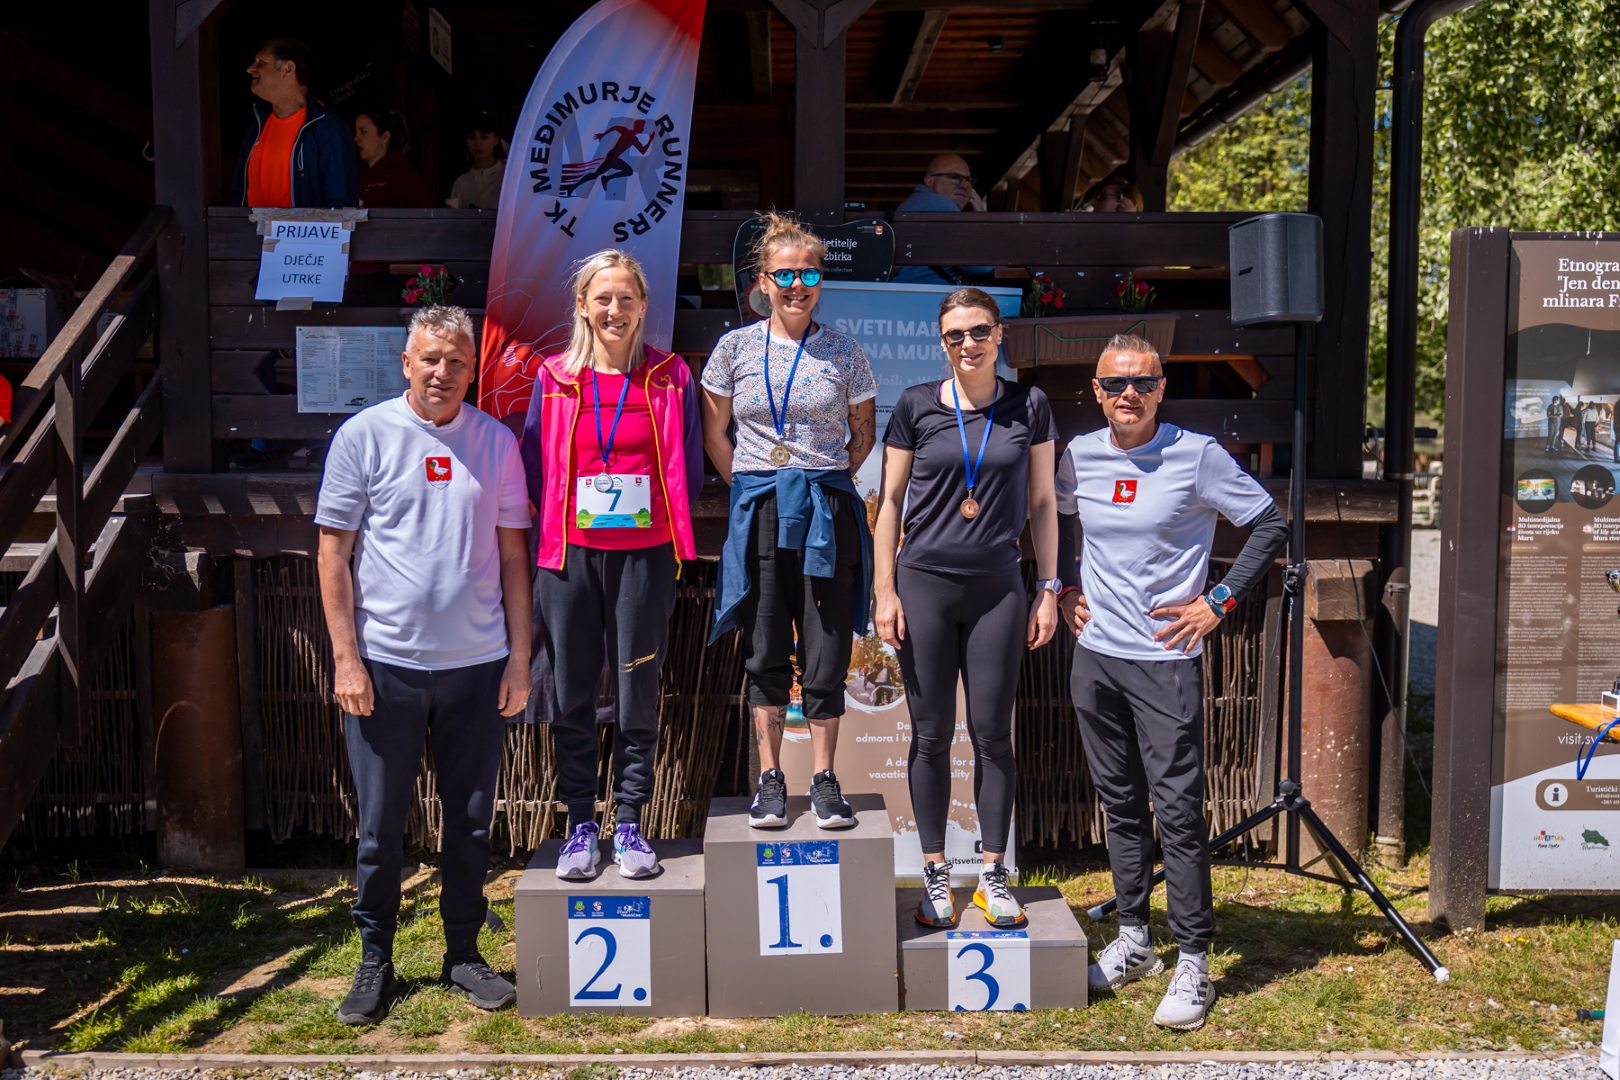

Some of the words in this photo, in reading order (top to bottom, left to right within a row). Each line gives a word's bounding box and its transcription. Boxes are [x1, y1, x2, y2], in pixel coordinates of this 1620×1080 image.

[530, 81, 656, 193] MEĐIMURJE
[613, 114, 683, 242] RUNNERS
[544, 200, 577, 238] TK
[276, 225, 341, 239] PRIJAVE
[284, 254, 325, 266] DJEČJE
[1558, 258, 1620, 275] Etnogra
[282, 273, 322, 285] UTRKE
[1557, 275, 1588, 293] "Jen
[1542, 293, 1605, 308] mlinara
[1608, 294, 1620, 308] F
[835, 318, 892, 336] SVETI
[864, 343, 893, 360] NA
[898, 344, 947, 360] MUR
[606, 488, 622, 512] 7
[855, 734, 894, 743] odmora
[896, 734, 899, 743] i
[1558, 732, 1606, 745] visit.sv
[885, 758, 893, 766] A
[952, 757, 966, 766] for
[766, 873, 834, 949] 1.
[574, 926, 647, 1001] 2.
[955, 942, 1026, 1011] 3.
